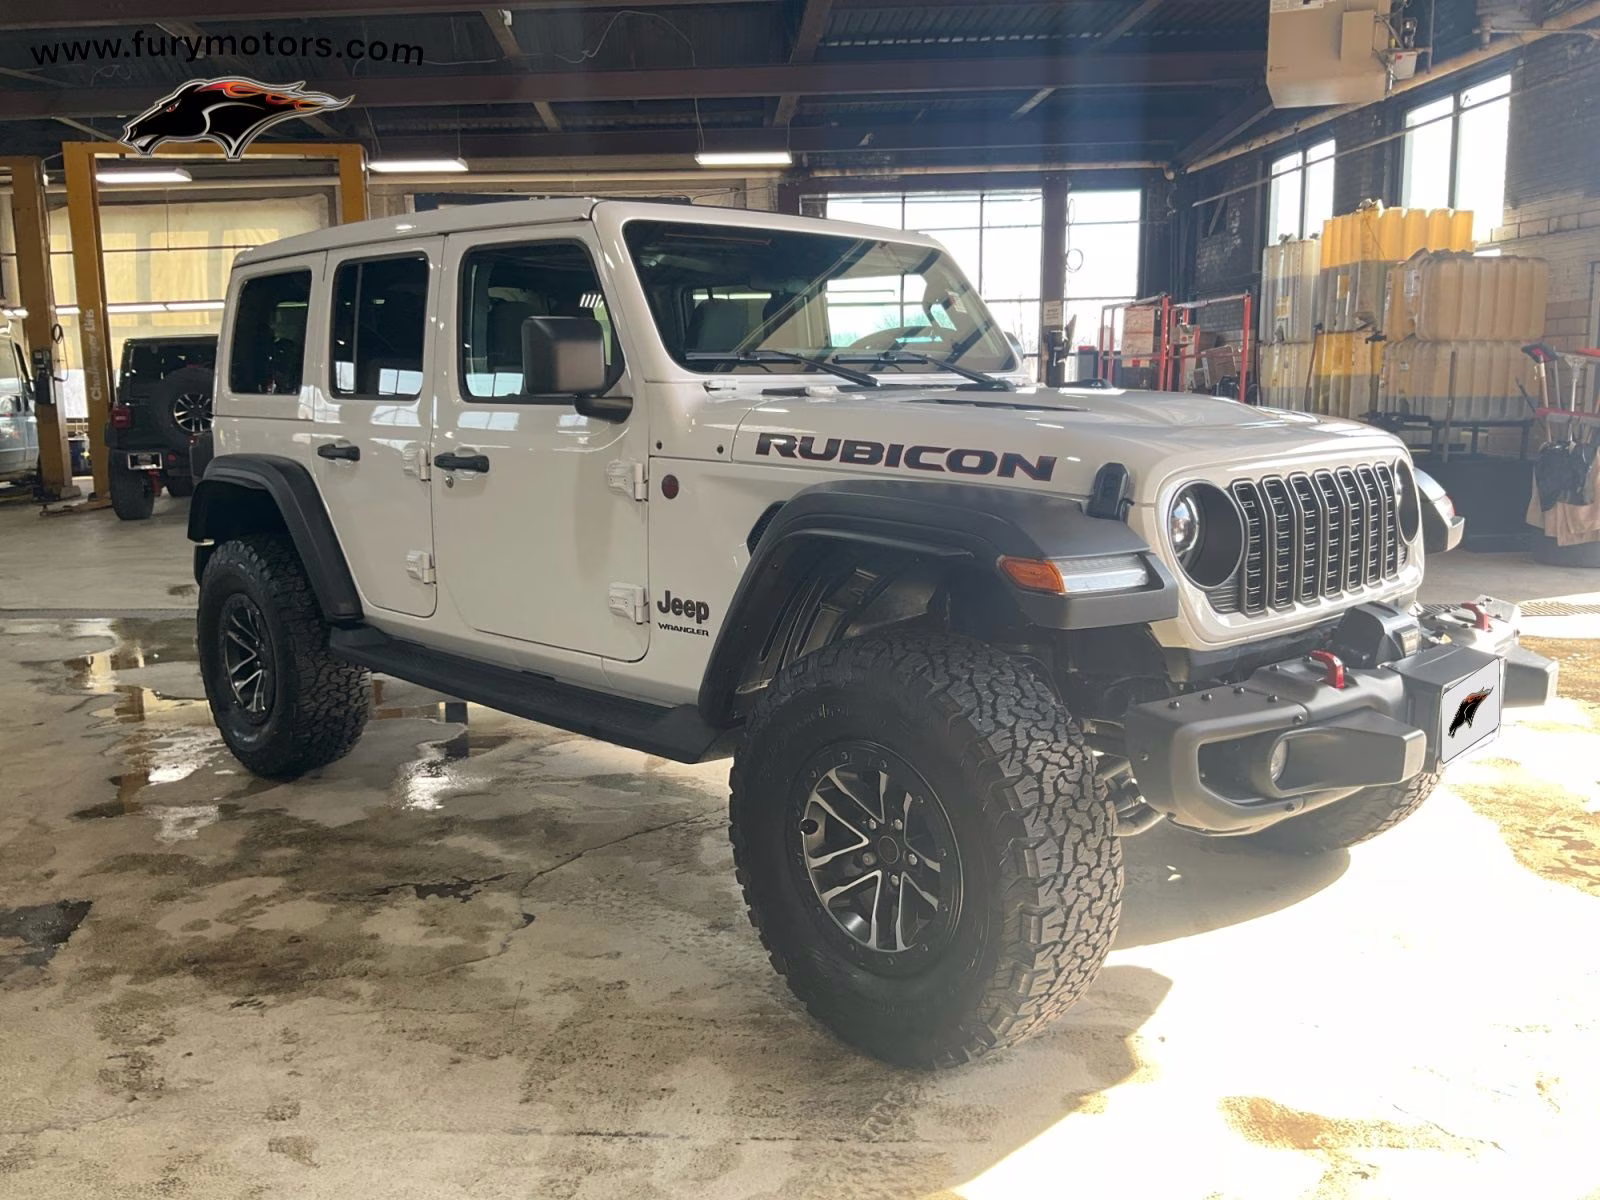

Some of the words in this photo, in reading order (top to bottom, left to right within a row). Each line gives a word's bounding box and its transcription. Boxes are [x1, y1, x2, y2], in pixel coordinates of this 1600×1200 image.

[755, 432, 1058, 482] RUBICON
[657, 590, 709, 624] Jeep
[658, 622, 709, 637] WRANGLER
